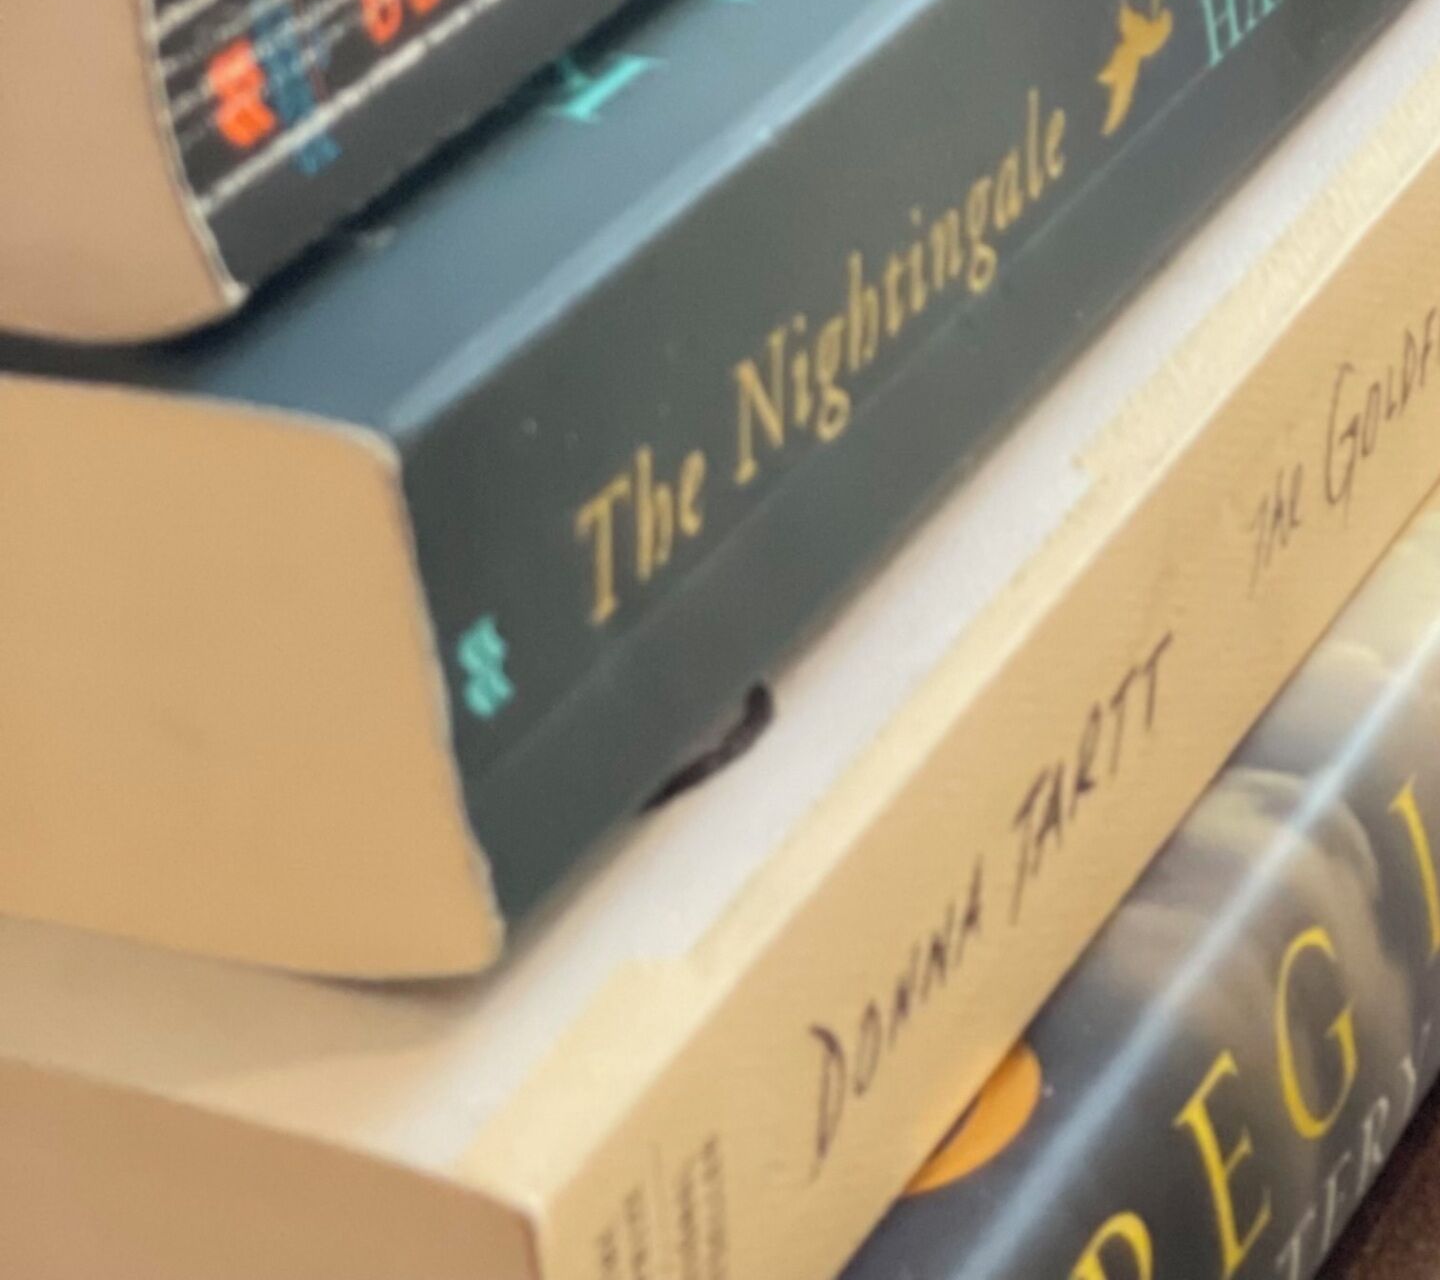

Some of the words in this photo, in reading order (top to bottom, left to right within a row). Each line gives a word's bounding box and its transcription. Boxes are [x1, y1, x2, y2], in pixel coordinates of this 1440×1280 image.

[575, 444, 705, 626] The
[733, 87, 1067, 486] Nightingale
[809, 852, 984, 1185] DONNA
[1010, 630, 1174, 928] TARTT
